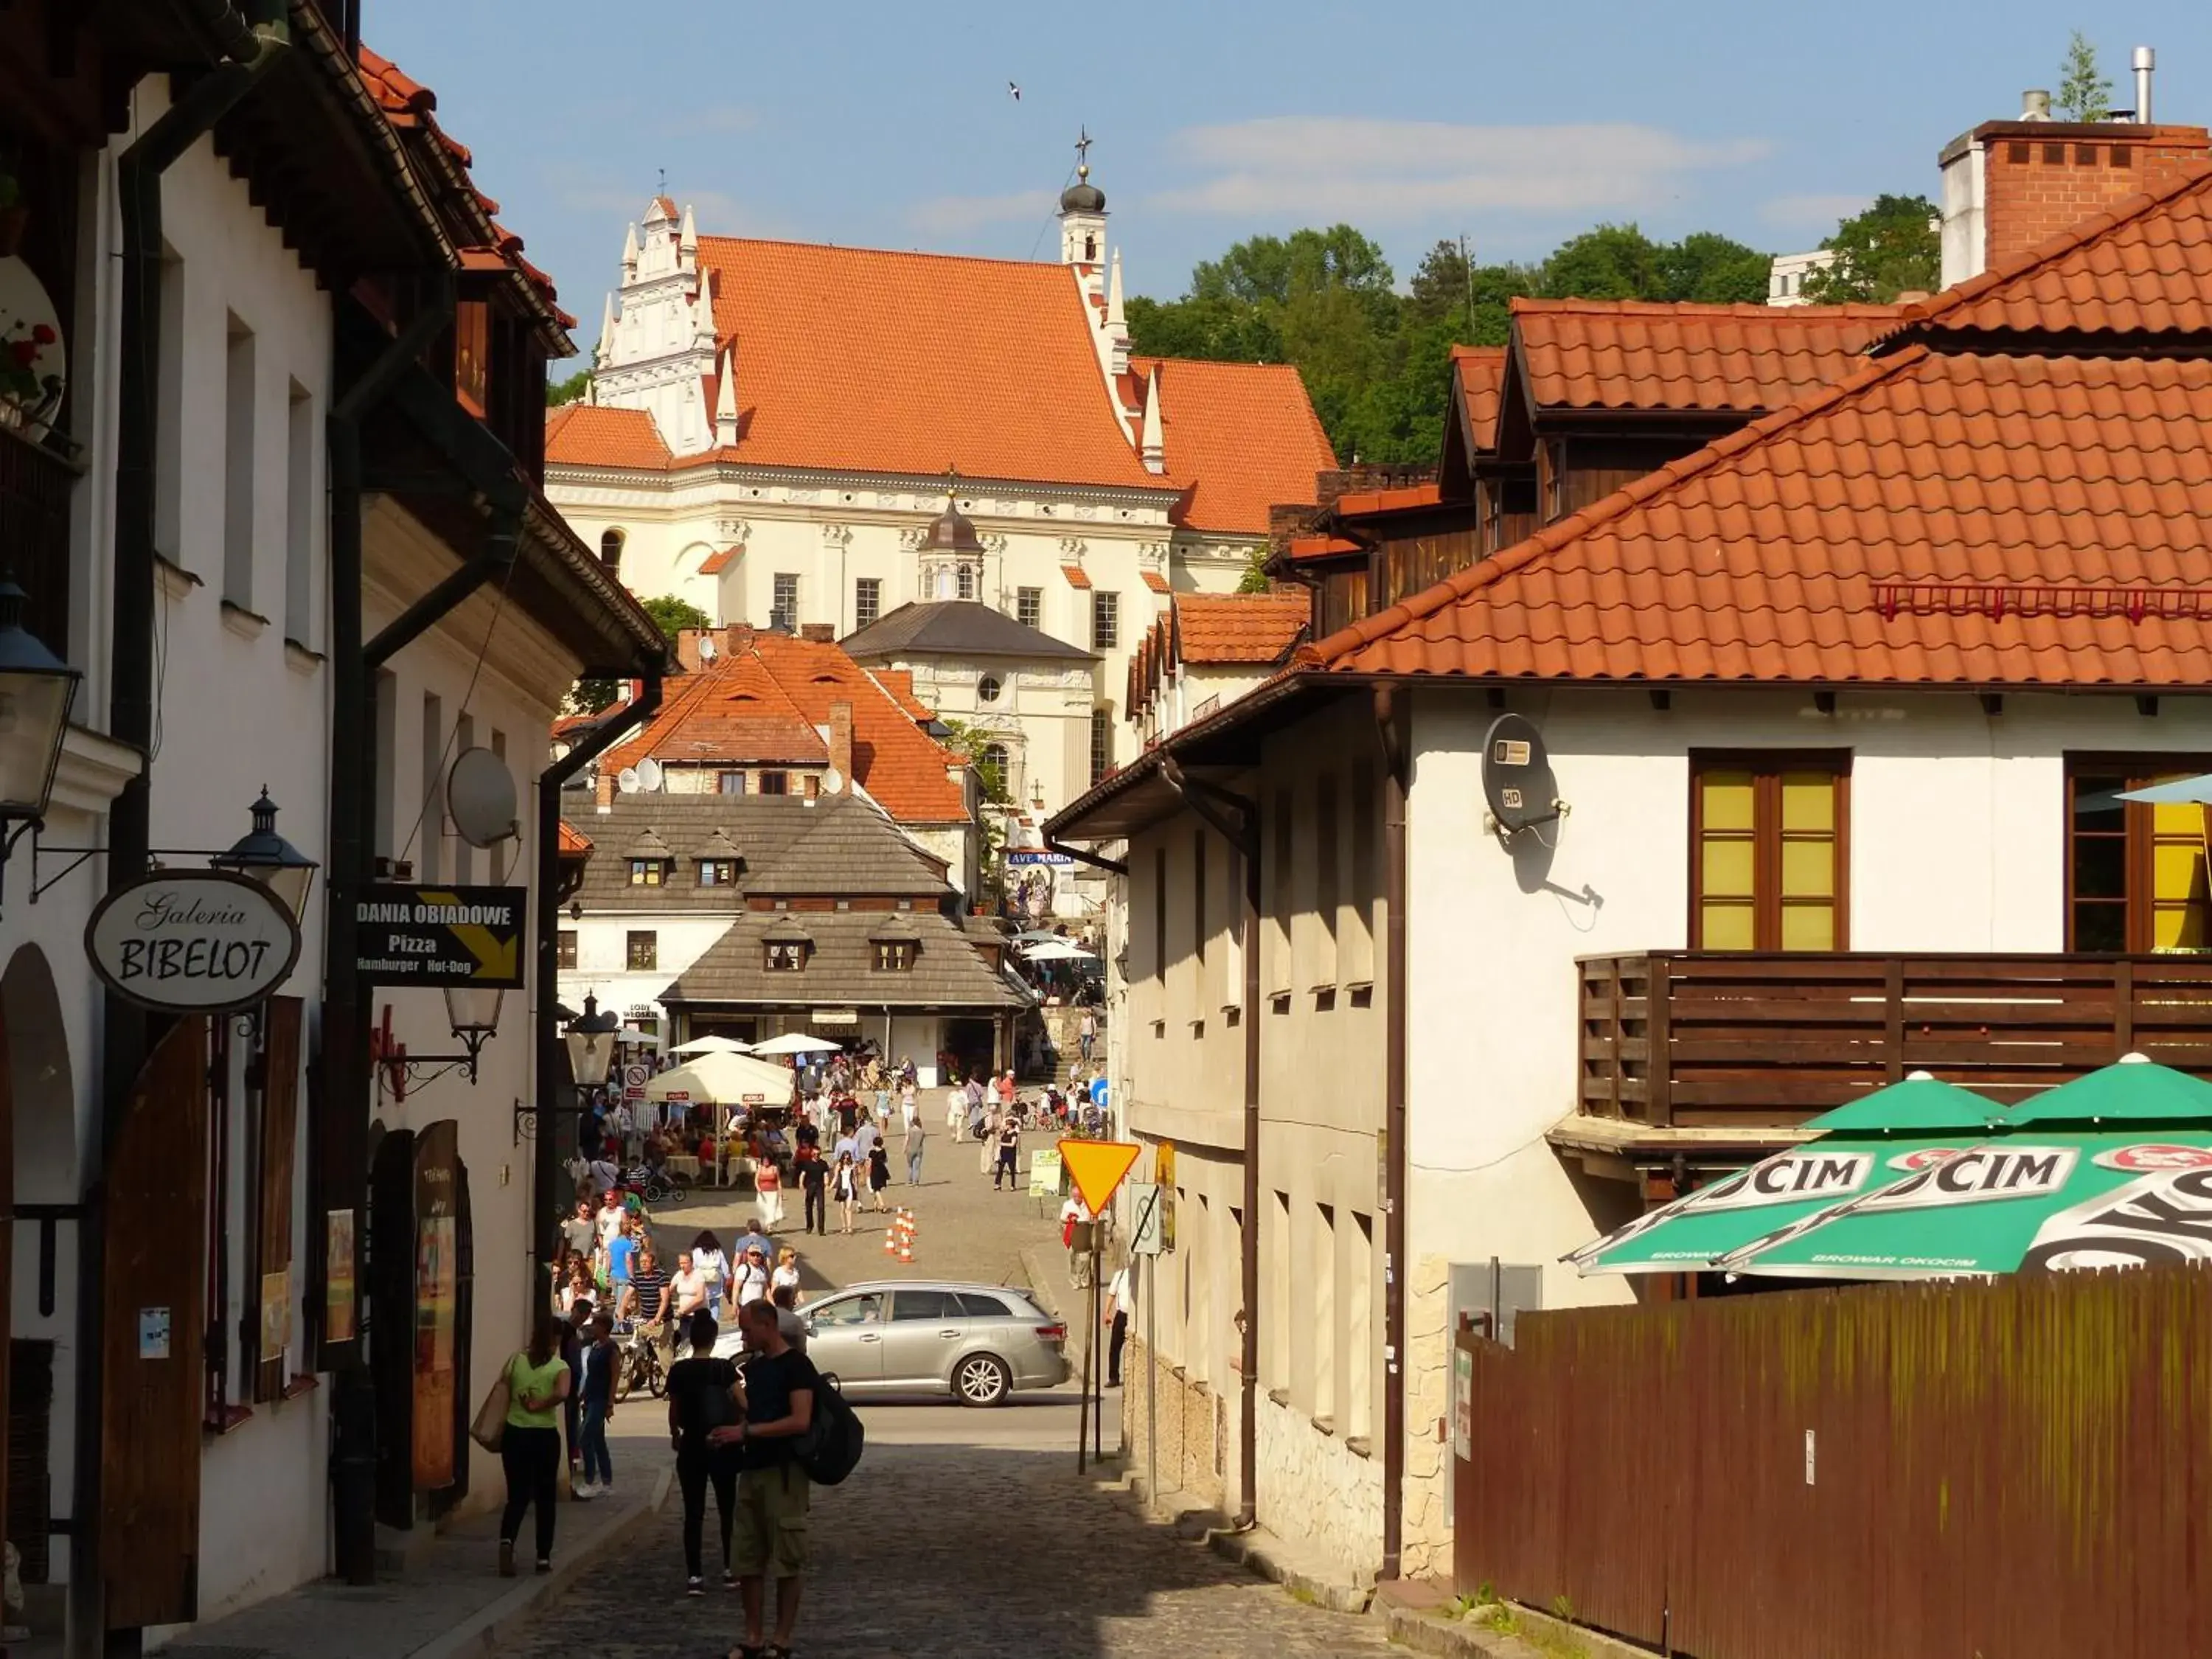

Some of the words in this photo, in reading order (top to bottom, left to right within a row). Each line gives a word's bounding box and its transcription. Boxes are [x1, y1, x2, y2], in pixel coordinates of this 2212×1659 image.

[1503, 791, 1520, 804] HD
[1012, 854, 1032, 863] AVE
[1037, 853, 1071, 863] MARIA
[135, 890, 246, 931] Galeria
[357, 902, 411, 923] DANIA
[414, 904, 511, 926] OBIADOWE
[389, 934, 437, 953] Pizza
[119, 938, 271, 981] BIBELOT
[357, 958, 420, 973] Hamburger
[427, 959, 471, 974] Hot-Dog
[1811, 1254, 1896, 1264] BROWAR
[1900, 1257, 1978, 1267] OKOCIM
